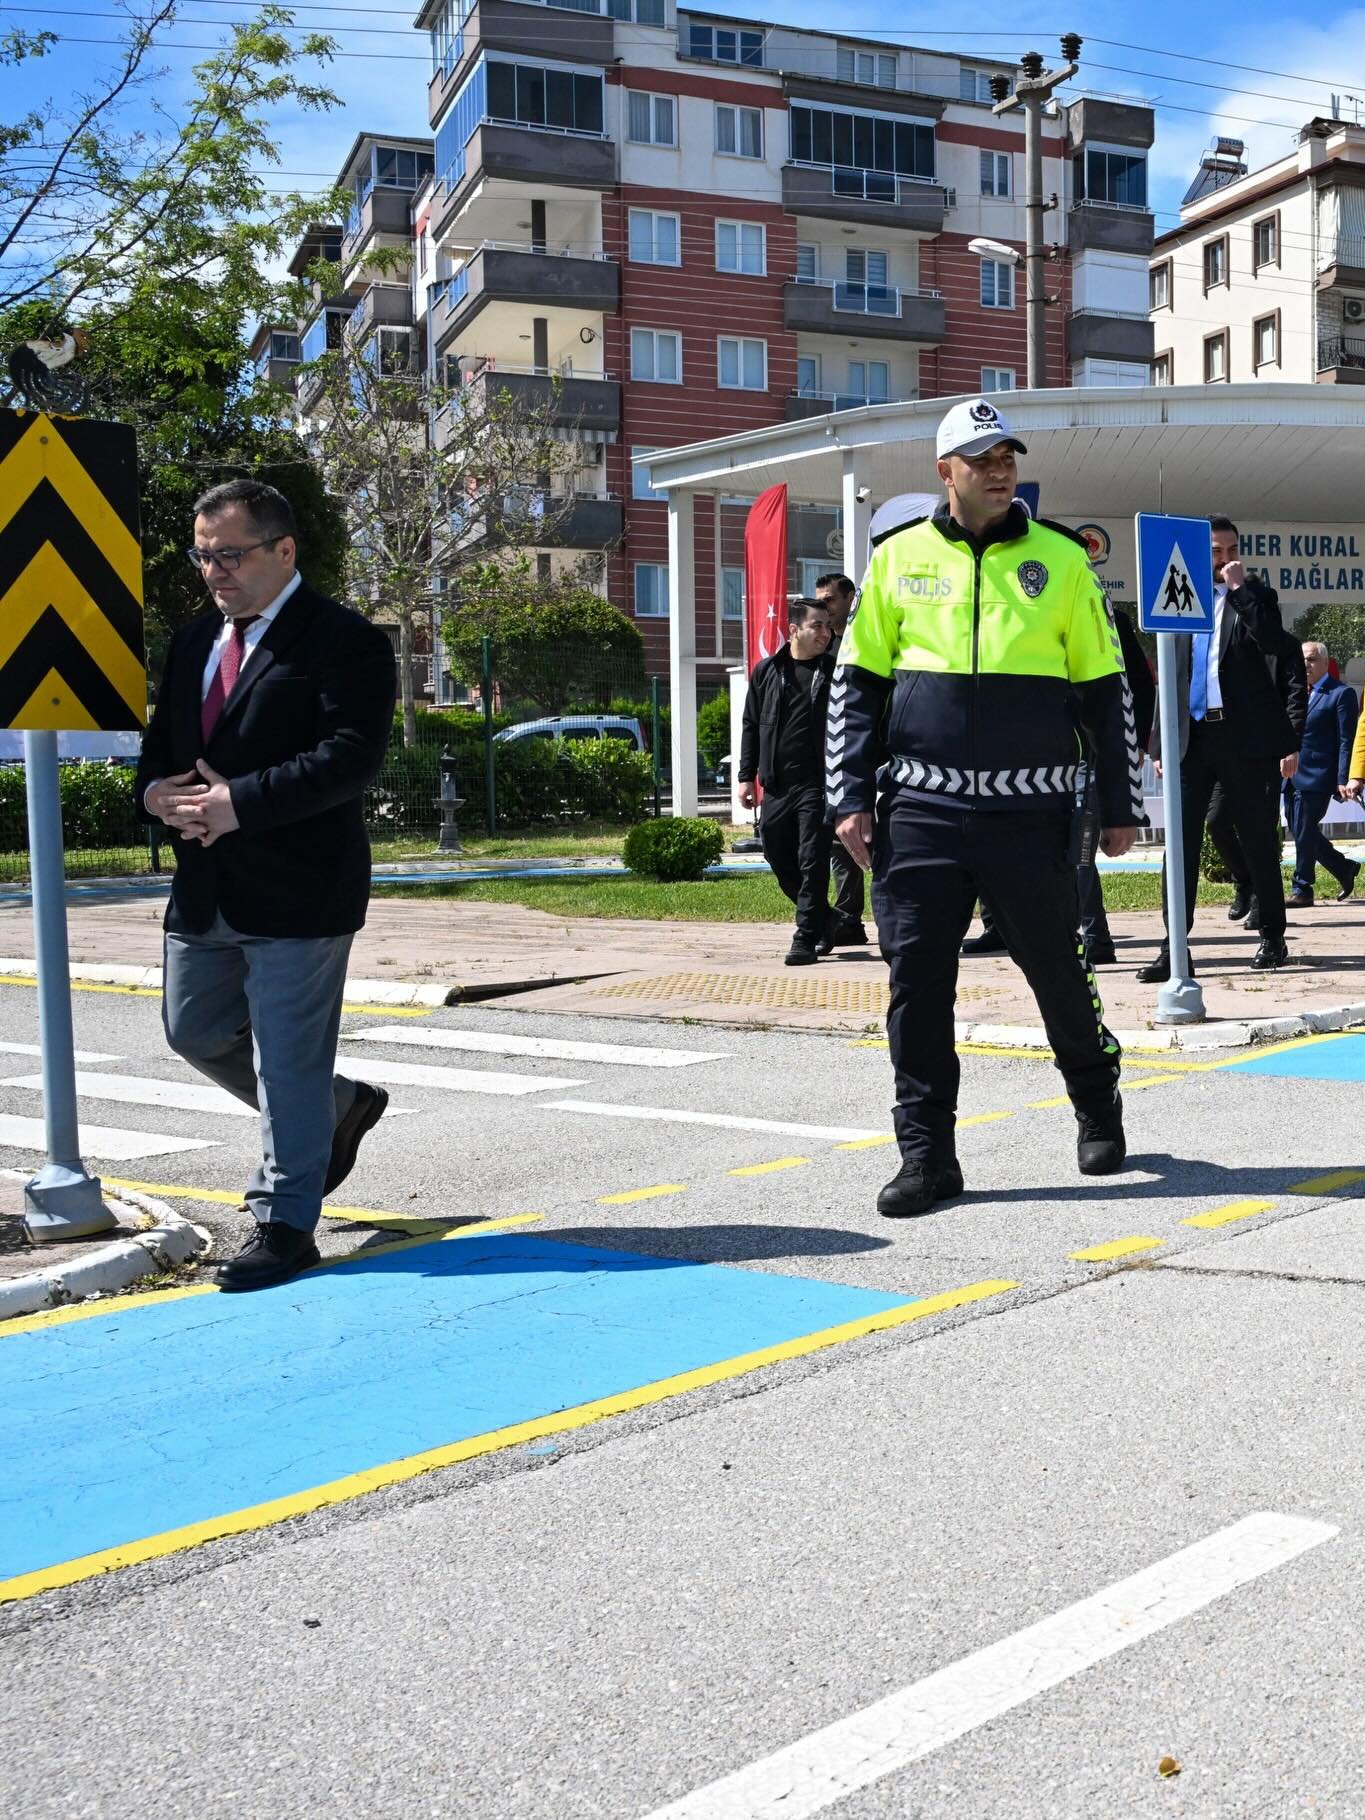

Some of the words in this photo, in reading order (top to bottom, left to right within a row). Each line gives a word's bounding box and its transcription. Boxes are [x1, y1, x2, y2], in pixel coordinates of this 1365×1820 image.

[1239, 534, 1281, 556] HER
[1290, 535, 1360, 557] KURAL
[1280, 562, 1364, 590] BAĞLAR
